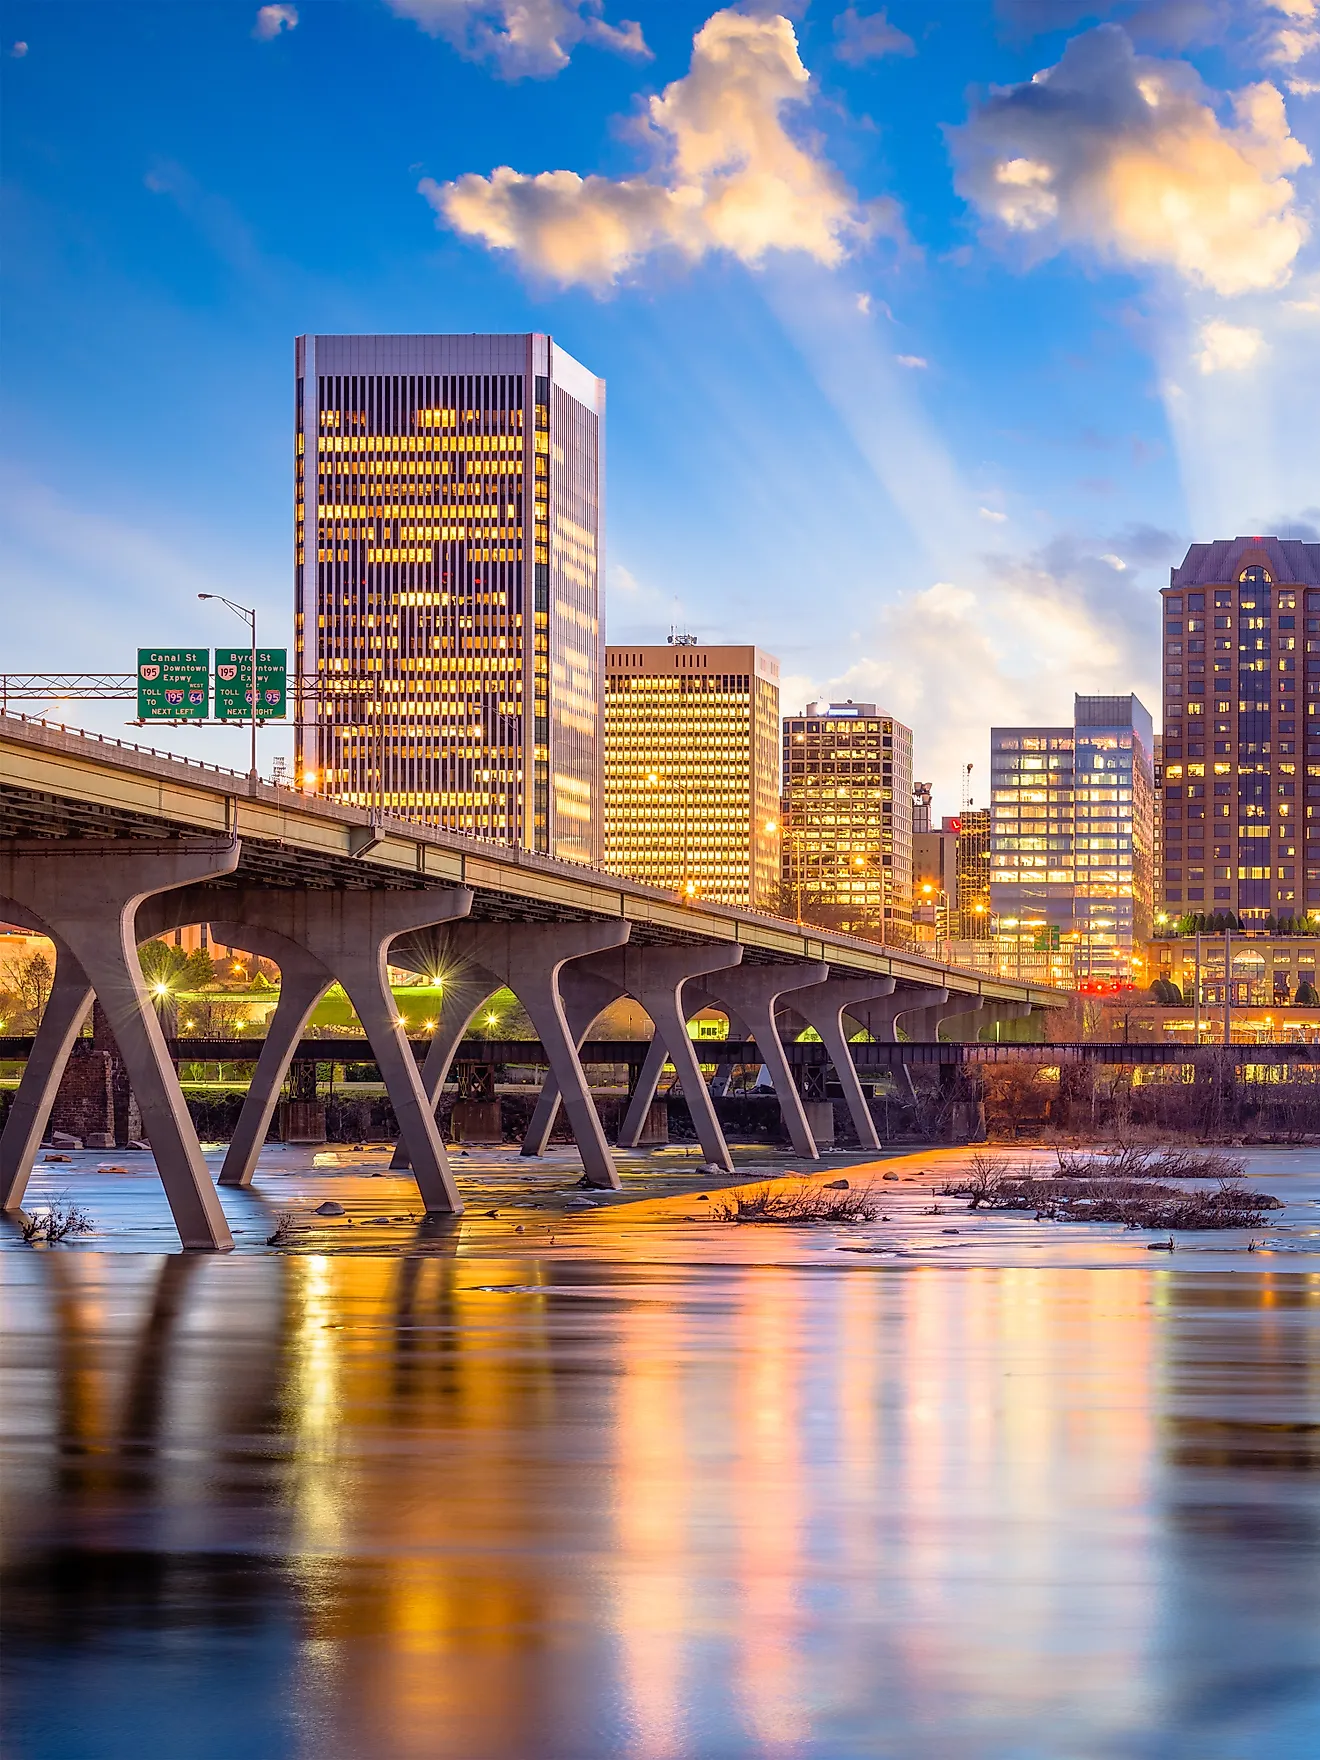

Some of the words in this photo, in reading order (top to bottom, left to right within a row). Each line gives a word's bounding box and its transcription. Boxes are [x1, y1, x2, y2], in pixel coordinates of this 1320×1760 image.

[150, 653, 180, 662] Canal
[185, 653, 197, 662] St
[259, 653, 271, 662] St
[144, 668, 157, 677] 195
[220, 668, 234, 677] 195
[240, 664, 284, 672] Dontown
[163, 674, 191, 683] Expwy
[240, 674, 269, 683] Exwy
[167, 693, 182, 702] 195
[190, 693, 202, 702] 64
[266, 693, 279, 702] 95
